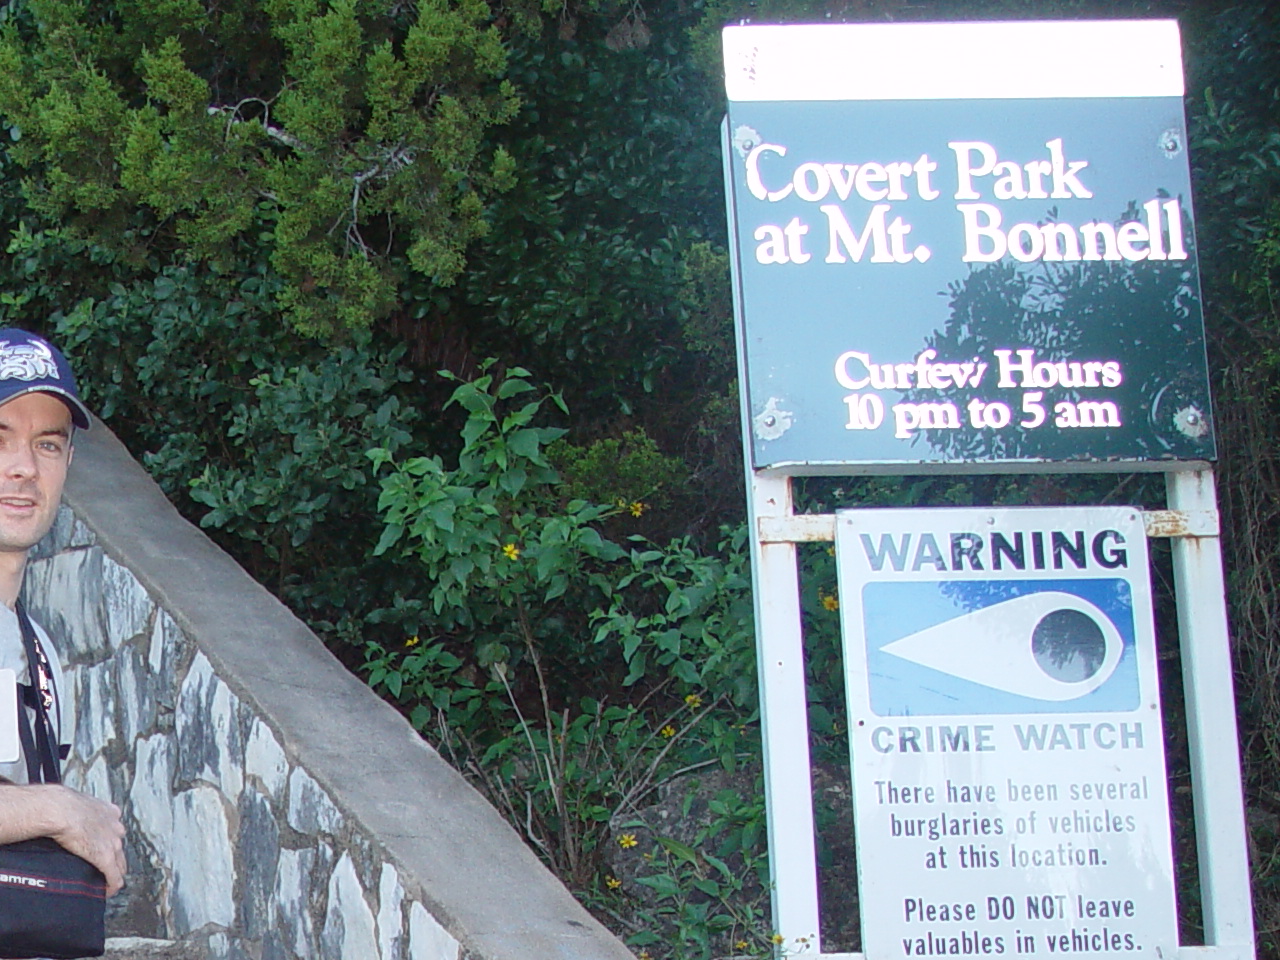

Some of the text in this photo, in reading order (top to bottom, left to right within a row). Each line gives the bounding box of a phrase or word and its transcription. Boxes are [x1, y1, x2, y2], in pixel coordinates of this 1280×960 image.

[746, 139, 1092, 201] Covert Park
[754, 199, 1187, 264] at Mt. Bonnell
[834, 349, 1121, 389] Curfew Hours
[844, 392, 1121, 438] 10 pm to 5 am
[860, 530, 1128, 572] WARNING
[871, 722, 1144, 753] CRIME WATCH
[874, 777, 1148, 804] There have been several
[891, 810, 1135, 840] burglaries of vehicles
[925, 843, 1107, 869] at this location.
[904, 895, 1135, 922] Please DO NOT leave
[902, 929, 1142, 955] valuables in vehicles.
